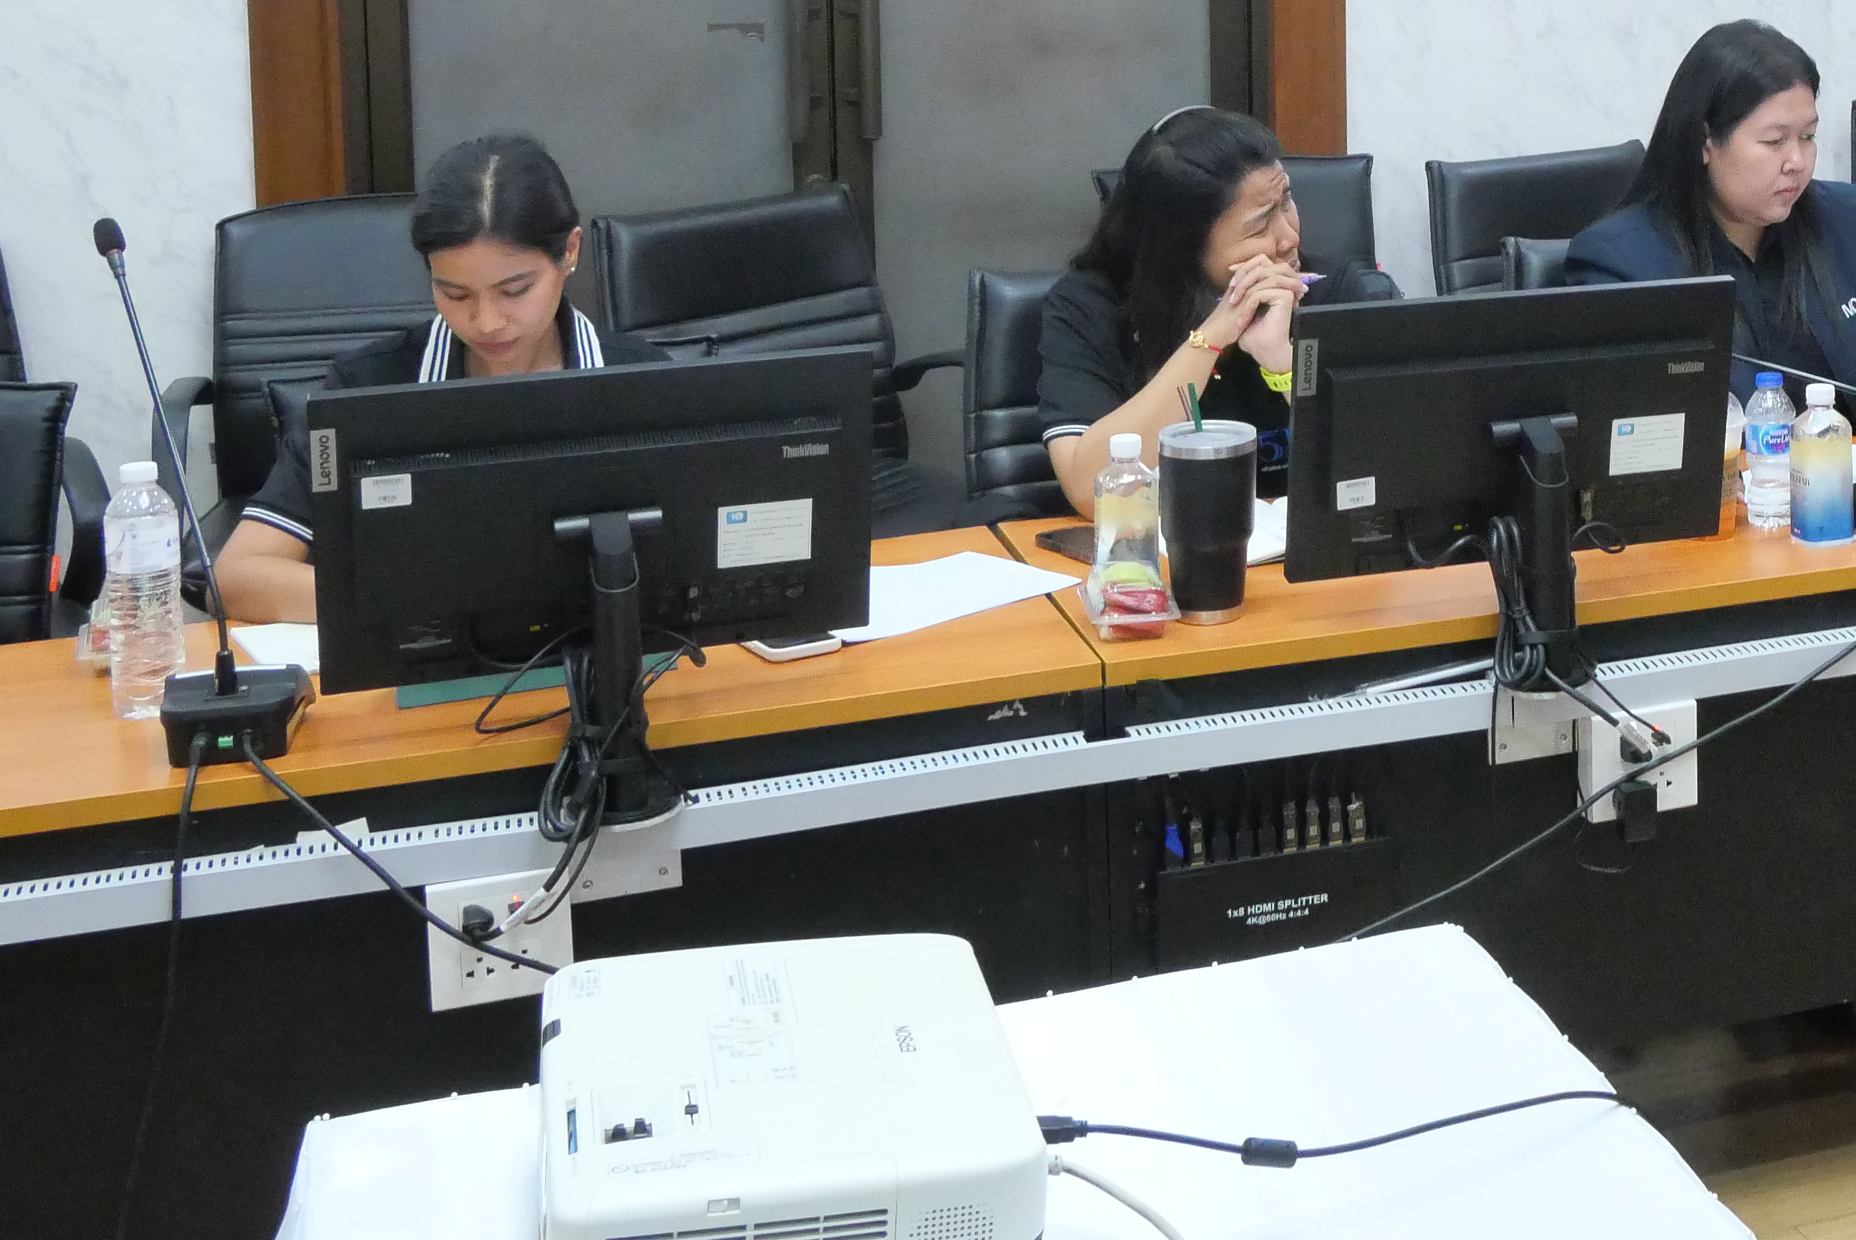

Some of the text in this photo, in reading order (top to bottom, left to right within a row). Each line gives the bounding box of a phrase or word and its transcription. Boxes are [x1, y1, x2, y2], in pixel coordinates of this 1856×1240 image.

[1301, 343, 1314, 392] Lenovo
[317, 434, 331, 489] Lenovo
[781, 442, 830, 460] ThinkVision
[1226, 892, 1329, 919] 1x8 HDMI SPLITTER
[1245, 907, 1310, 926] 4K@60Hz 4:4:4
[893, 1024, 917, 1053] EPSON
